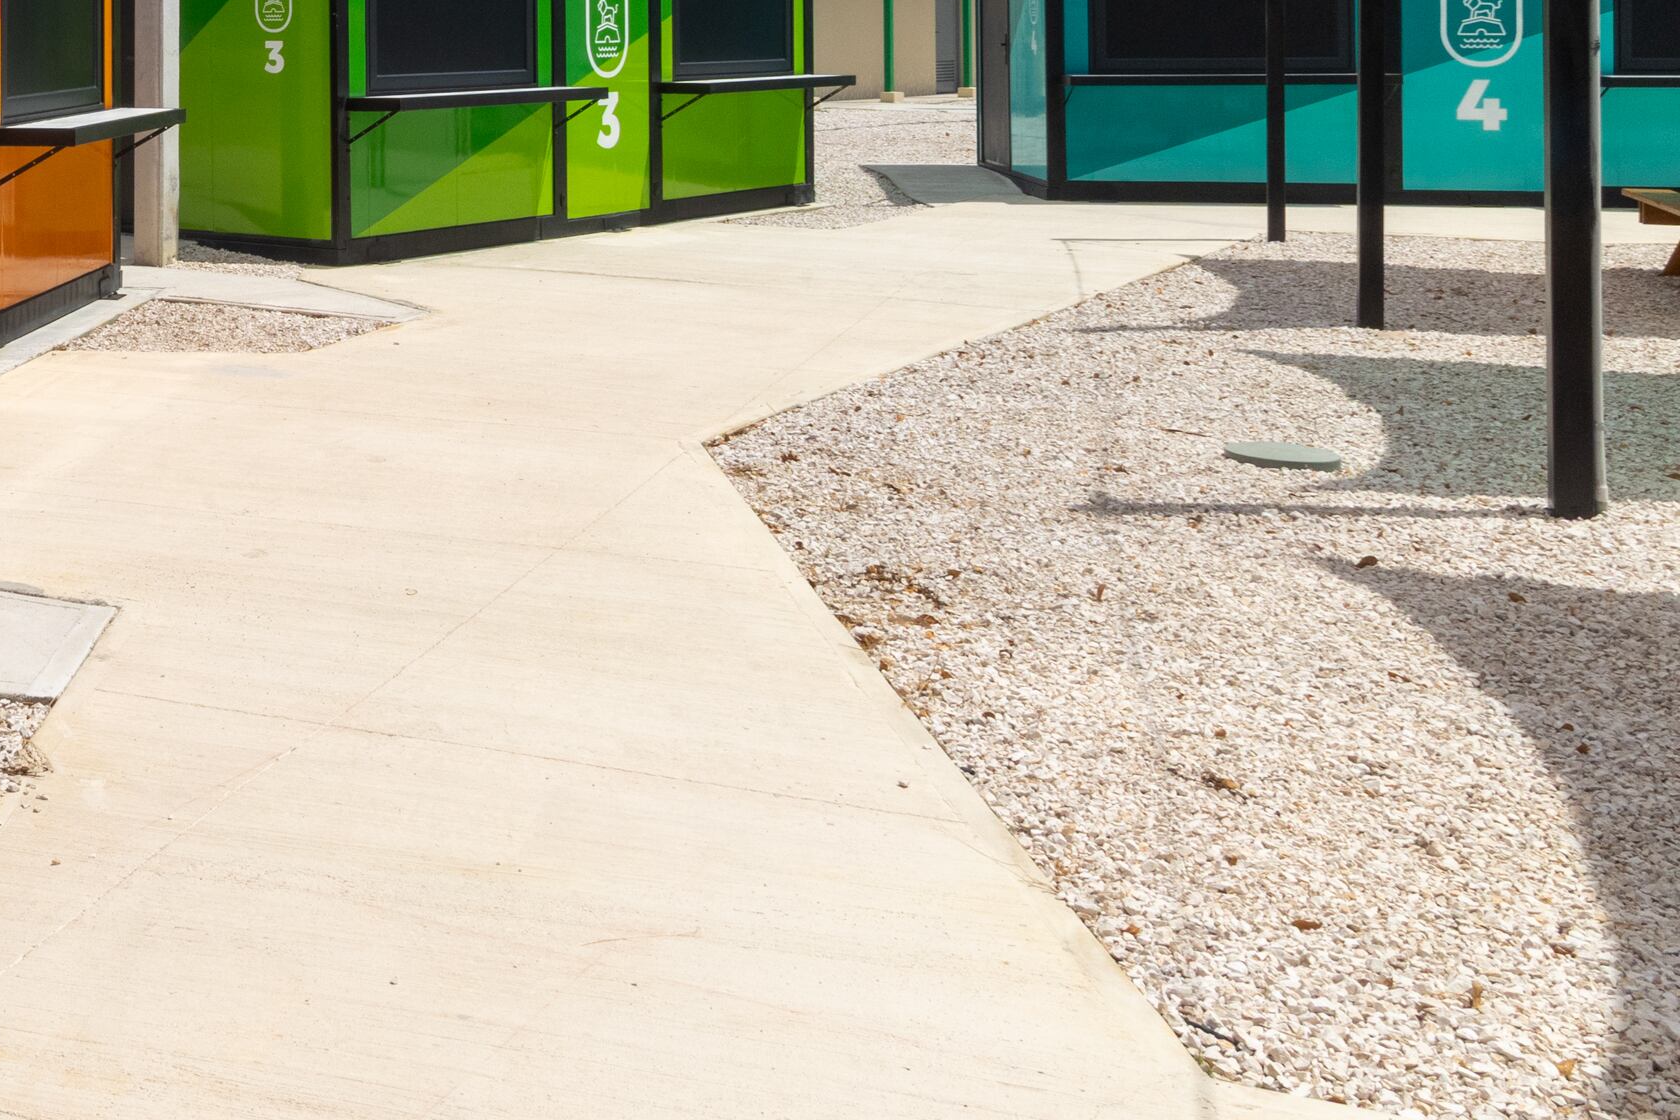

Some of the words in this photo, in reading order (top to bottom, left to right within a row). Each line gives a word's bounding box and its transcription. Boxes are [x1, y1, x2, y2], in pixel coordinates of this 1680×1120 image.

[264, 40, 285, 74] 3
[597, 91, 621, 149] 3
[1456, 79, 1508, 131] 4
